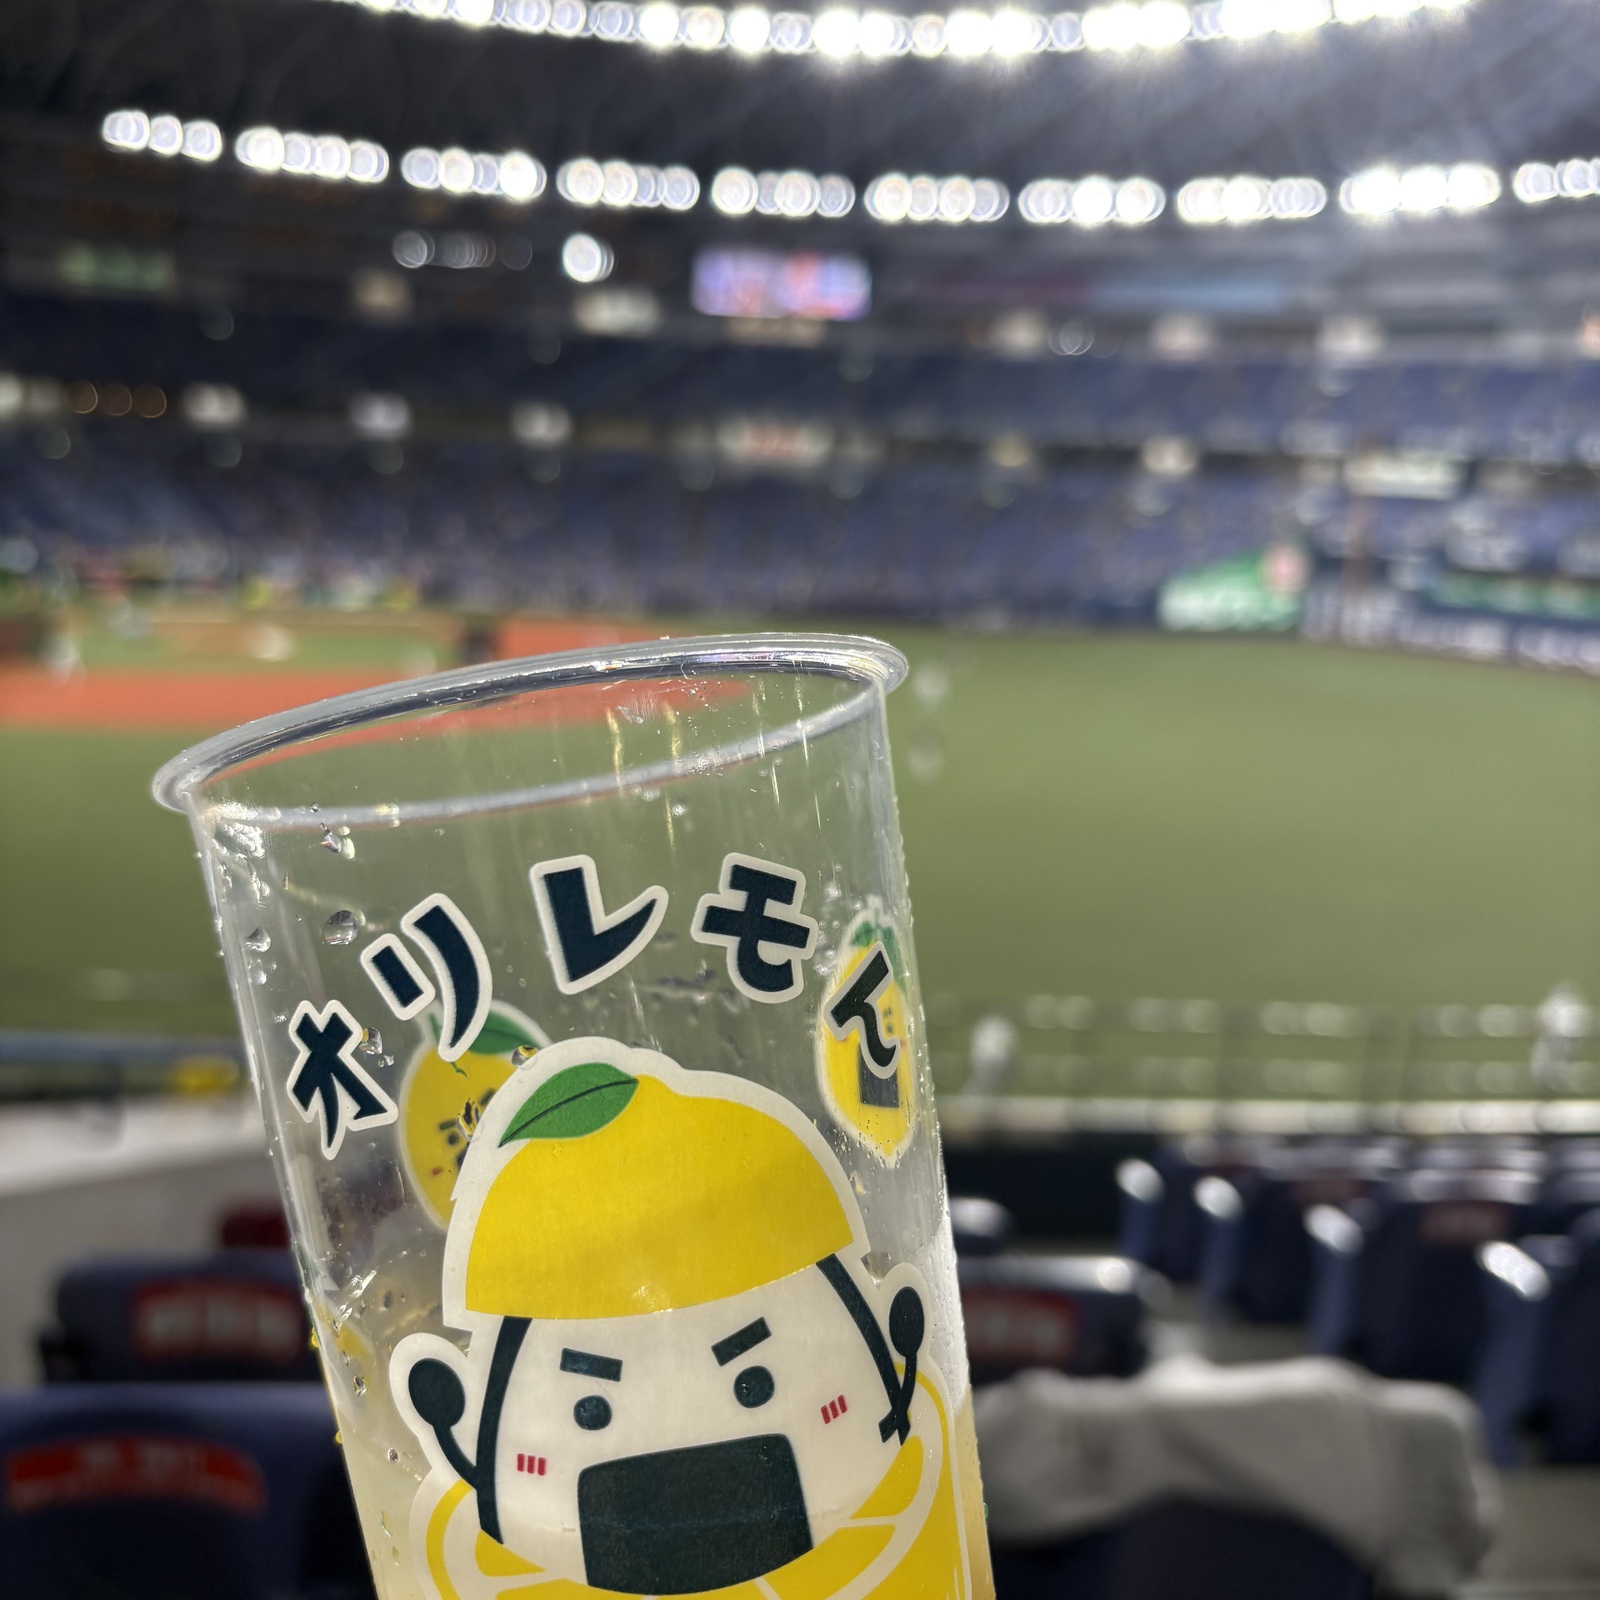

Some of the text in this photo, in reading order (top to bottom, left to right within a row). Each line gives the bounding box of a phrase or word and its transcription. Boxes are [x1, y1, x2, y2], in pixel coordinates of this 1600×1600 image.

[289, 859, 899, 1152] オリレモん
